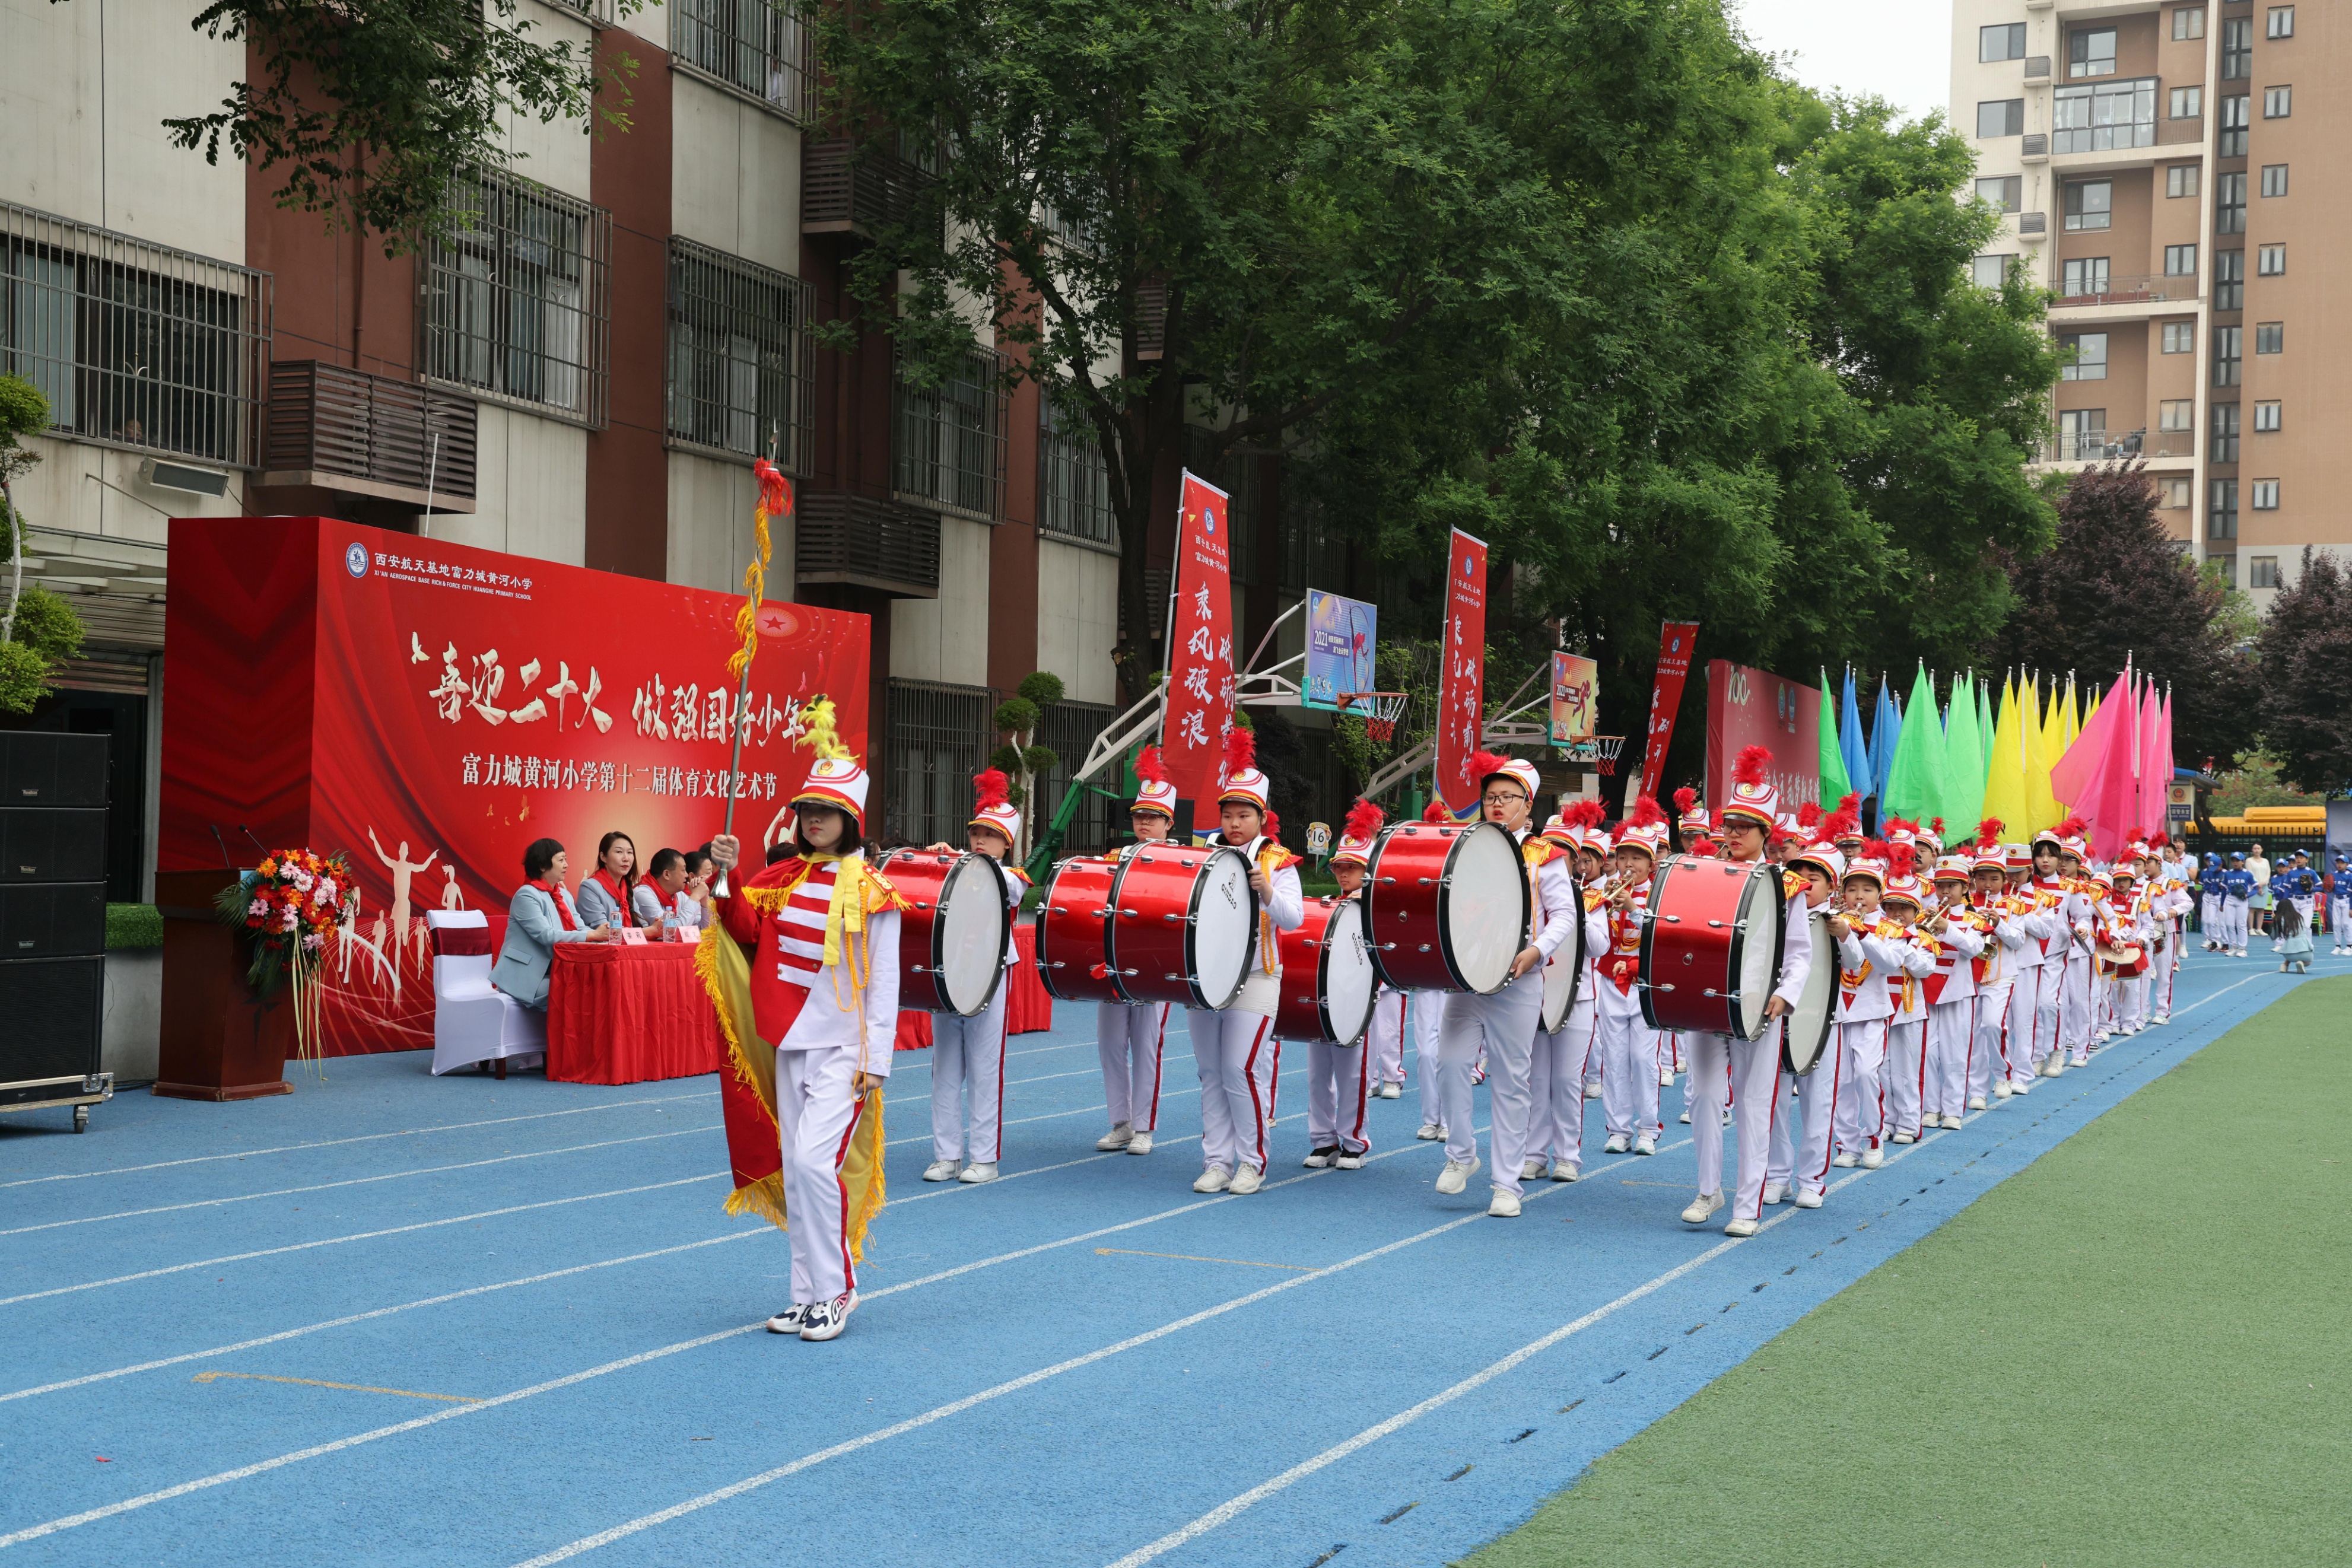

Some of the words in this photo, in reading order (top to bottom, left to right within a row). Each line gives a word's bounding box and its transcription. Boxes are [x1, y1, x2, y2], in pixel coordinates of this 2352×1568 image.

[1194, 535, 1226, 558] 西安航天基地
[374, 552, 533, 590] 西安航天基地富力城黄河小学
[1195, 552, 1228, 574] 富力城黄河小学
[389, 573, 417, 582] AEROSPACE
[473, 586, 494, 594] HUANGHE
[495, 589, 514, 597] PRIMARY
[1455, 593, 1480, 609] 力城黄河小学
[1314, 629, 1328, 647] 2021
[1180, 581, 1213, 750] 乘风破浪
[428, 641, 614, 734] 喜迎二十大
[631, 673, 806, 753] 做强国好少年
[1556, 683, 1565, 697] 2021
[1727, 665, 1750, 706] 100
[462, 752, 777, 801] 富力城黄河小学第十二届体育文化艺术节
[1313, 831, 1324, 842] 16
